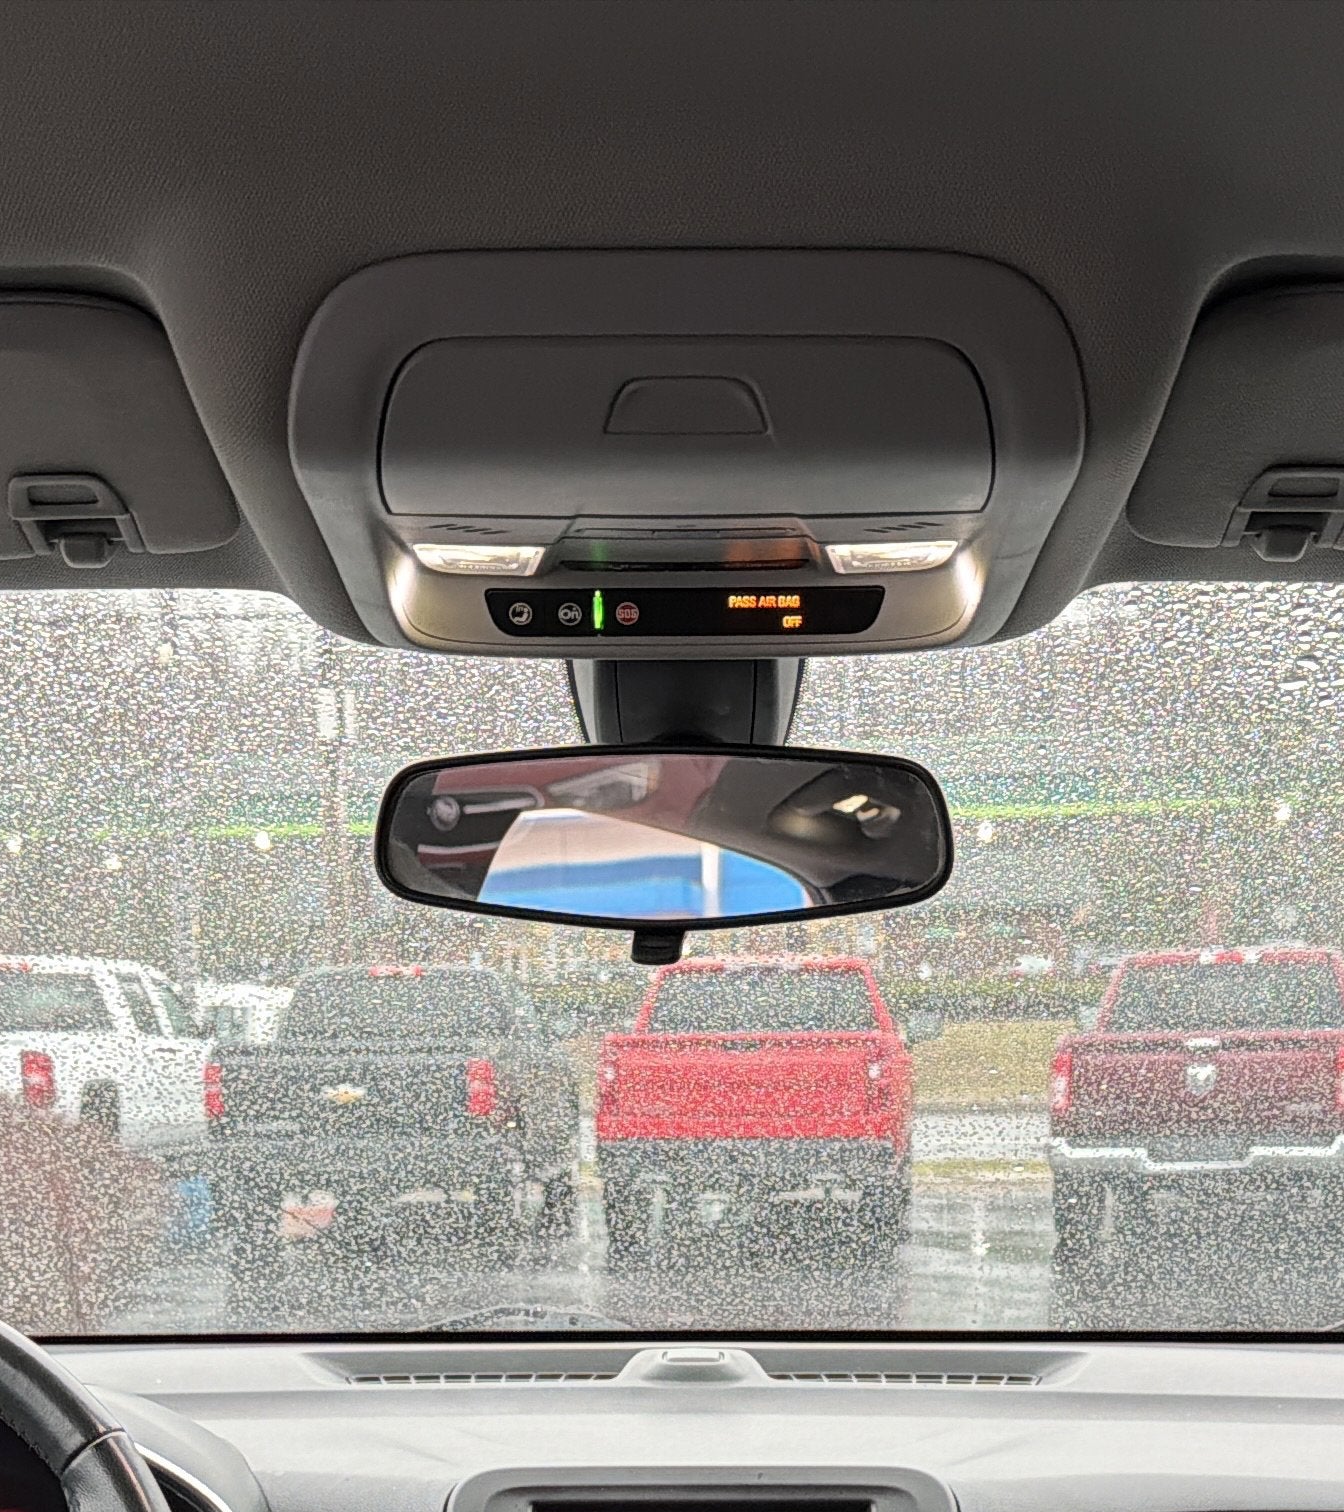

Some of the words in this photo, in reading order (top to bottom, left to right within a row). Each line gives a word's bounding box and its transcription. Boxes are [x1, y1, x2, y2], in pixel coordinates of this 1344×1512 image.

[728, 595, 757, 608] PASS
[758, 595, 777, 608] AIR
[778, 595, 800, 608] BAG
[617, 608, 638, 619] SOS
[782, 615, 803, 628] OFF
